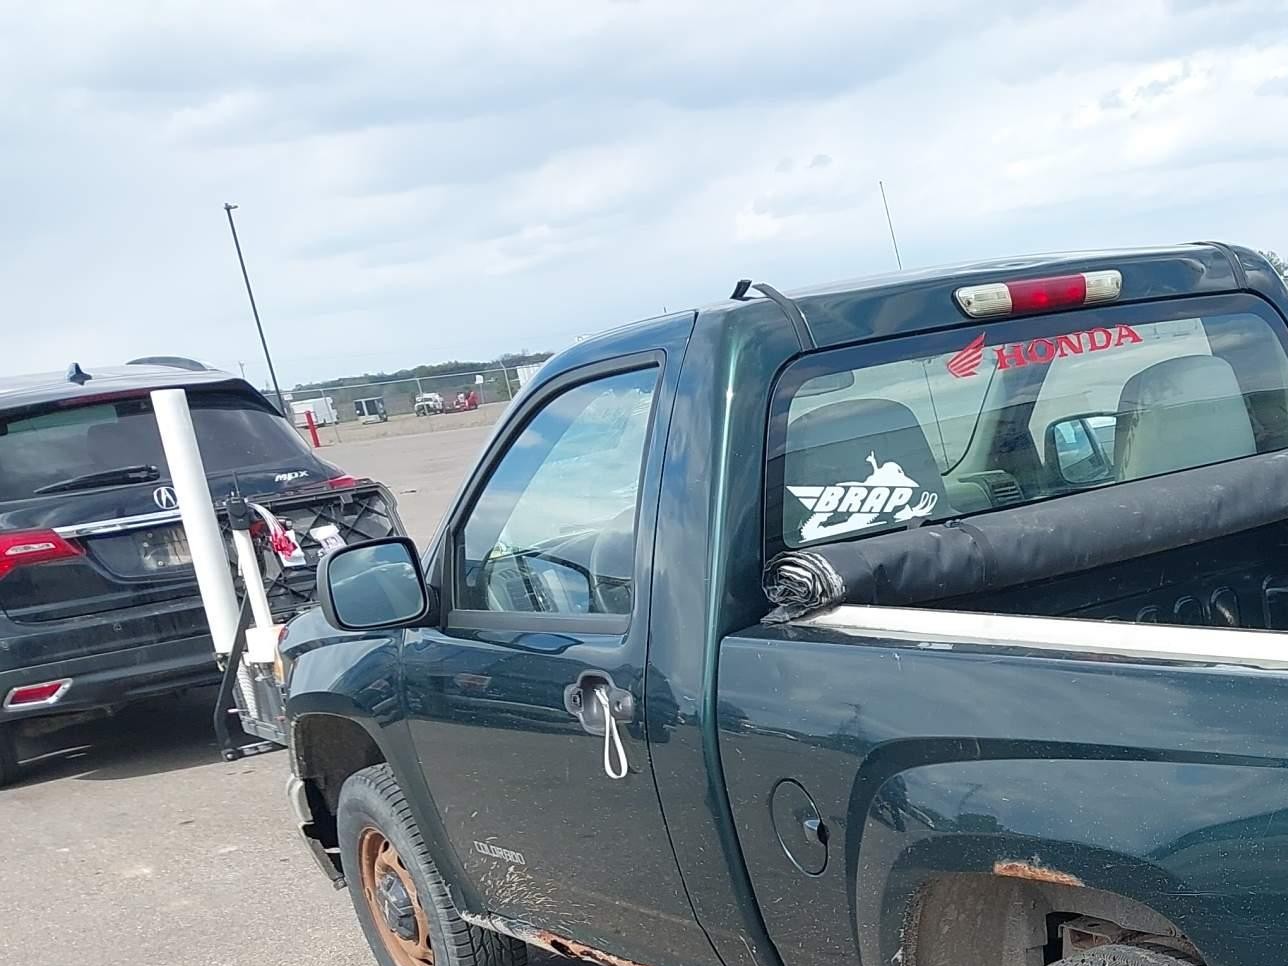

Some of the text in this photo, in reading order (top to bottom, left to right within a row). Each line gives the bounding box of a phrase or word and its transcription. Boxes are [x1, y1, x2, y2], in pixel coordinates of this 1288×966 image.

[993, 323, 1143, 370] HONDA
[274, 470, 309, 482] MDX
[813, 486, 913, 513] BRAP
[473, 840, 526, 865] COLORADO
